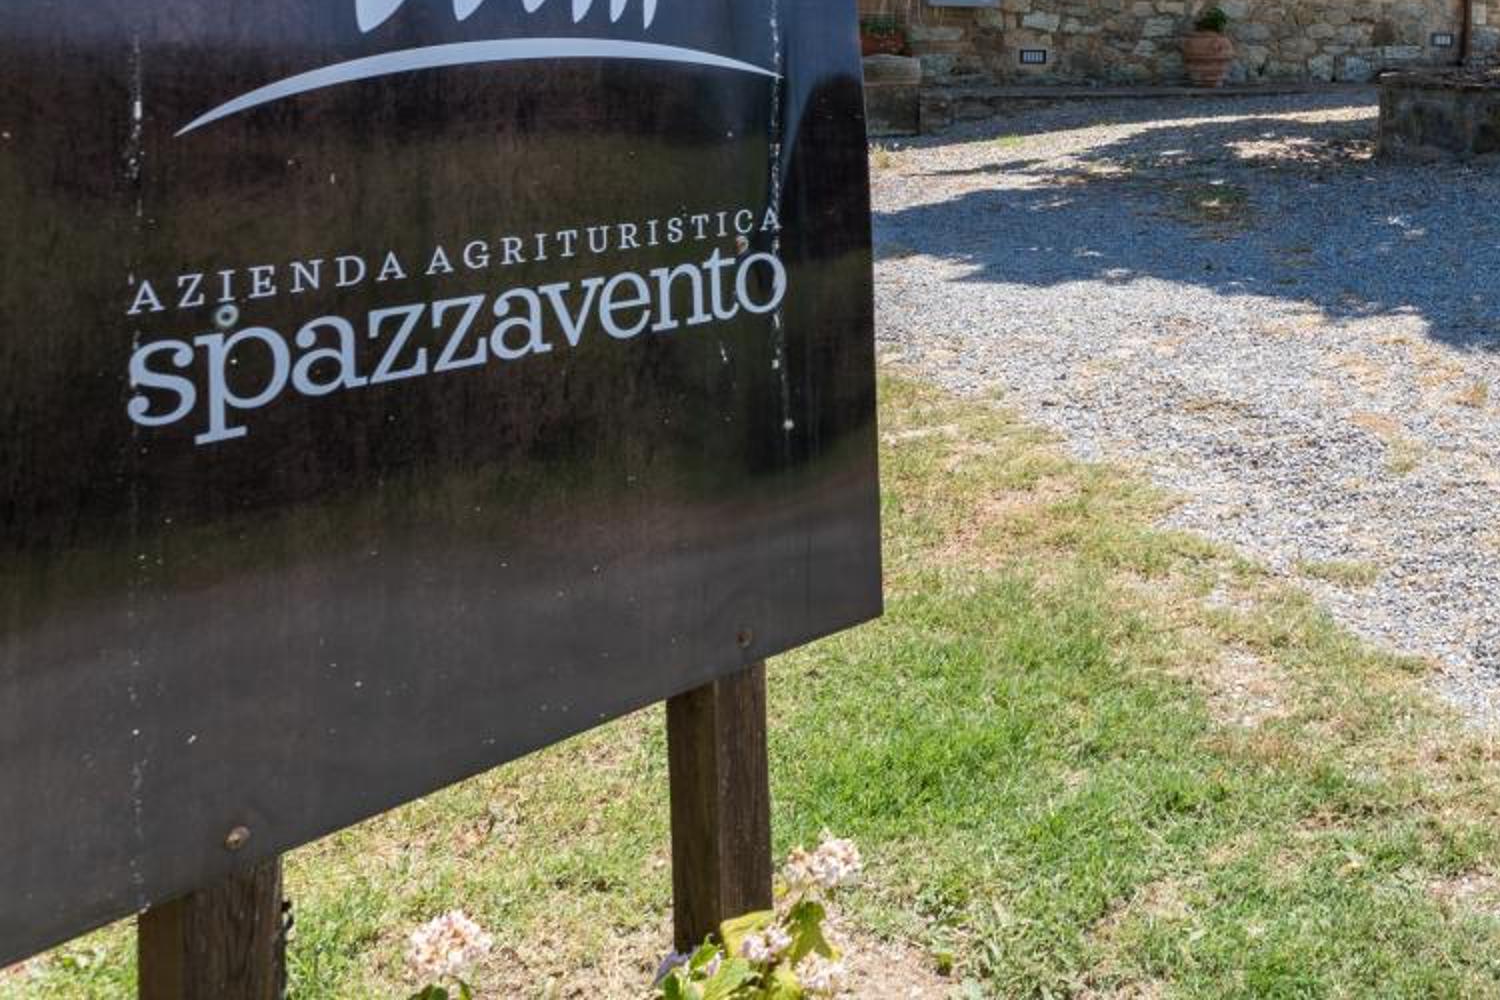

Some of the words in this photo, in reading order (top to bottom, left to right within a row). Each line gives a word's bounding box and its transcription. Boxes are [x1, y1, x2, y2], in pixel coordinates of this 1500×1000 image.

[127, 251, 406, 315] AZIENDA
[426, 208, 782, 275] AGRITURISTICA
[127, 247, 788, 445] spazzavento
